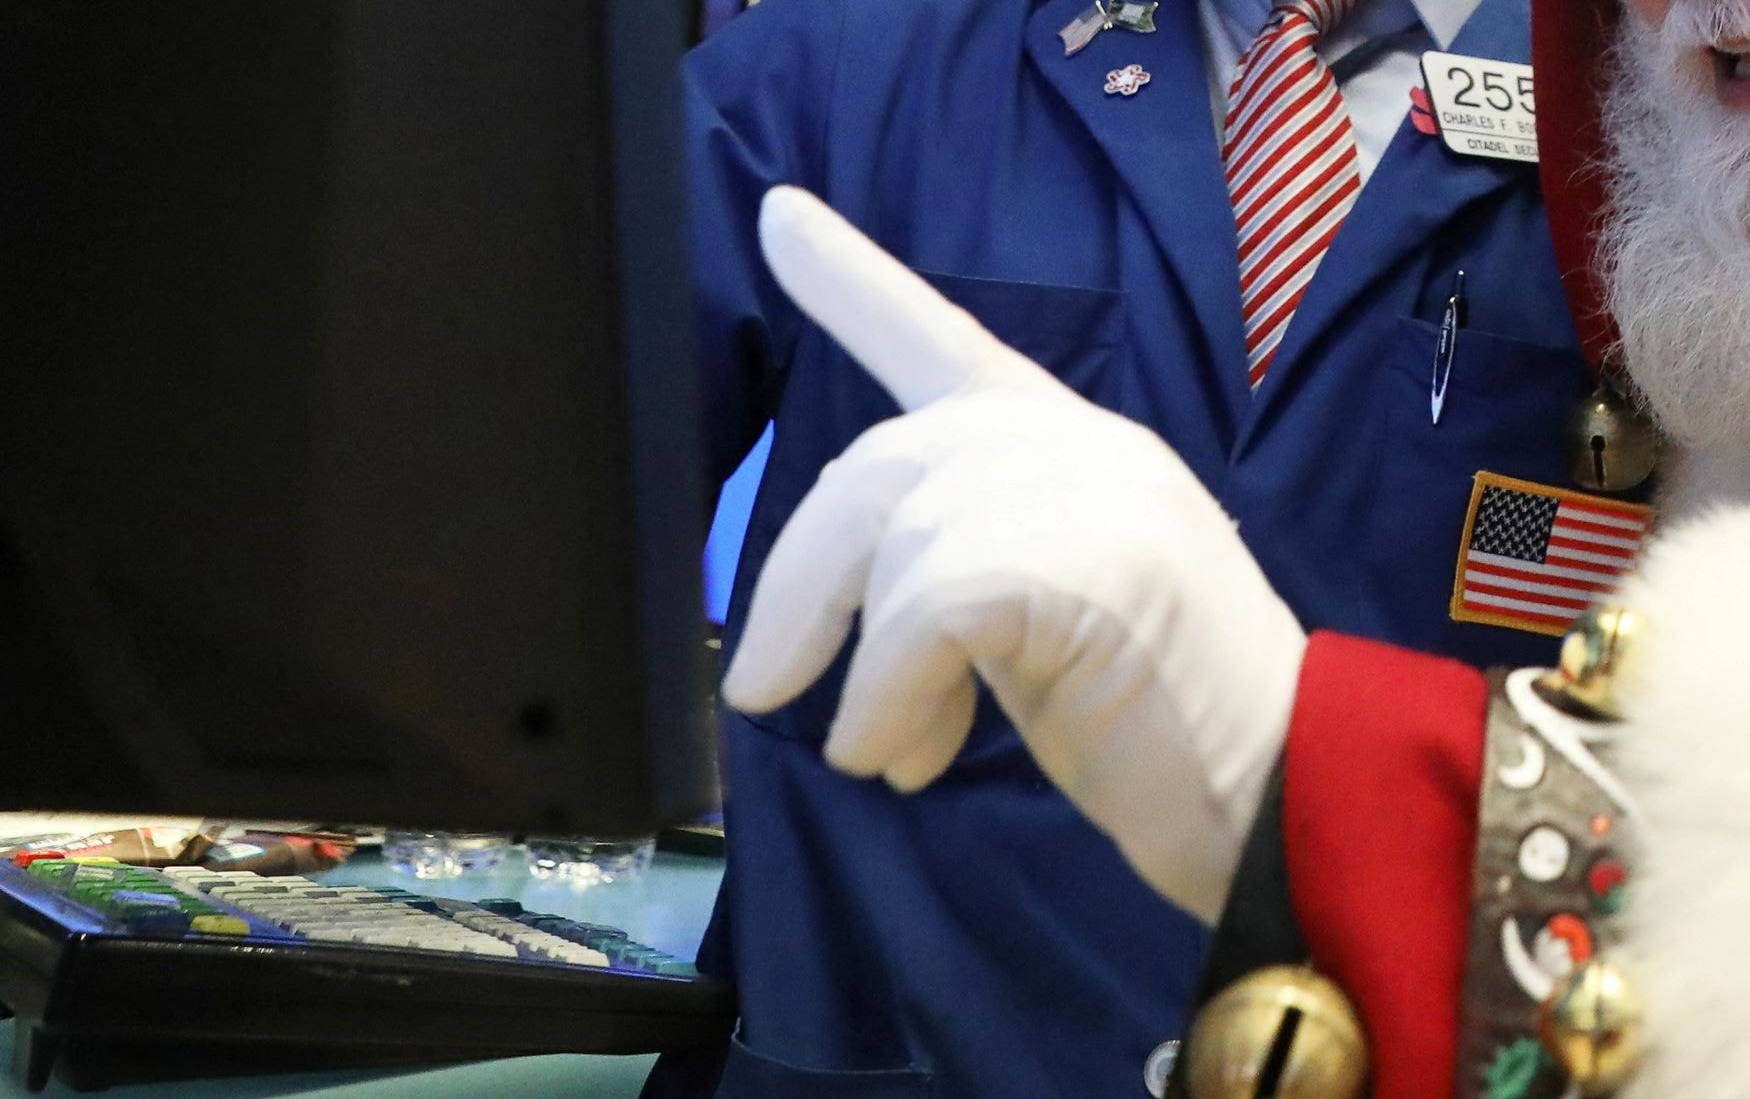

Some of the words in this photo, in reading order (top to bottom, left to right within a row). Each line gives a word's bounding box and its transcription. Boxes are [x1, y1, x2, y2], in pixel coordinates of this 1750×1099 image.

[1447, 67, 1535, 114] 255
[1443, 111, 1495, 130] CHARLES
[1467, 138, 1509, 154] CITADEL
